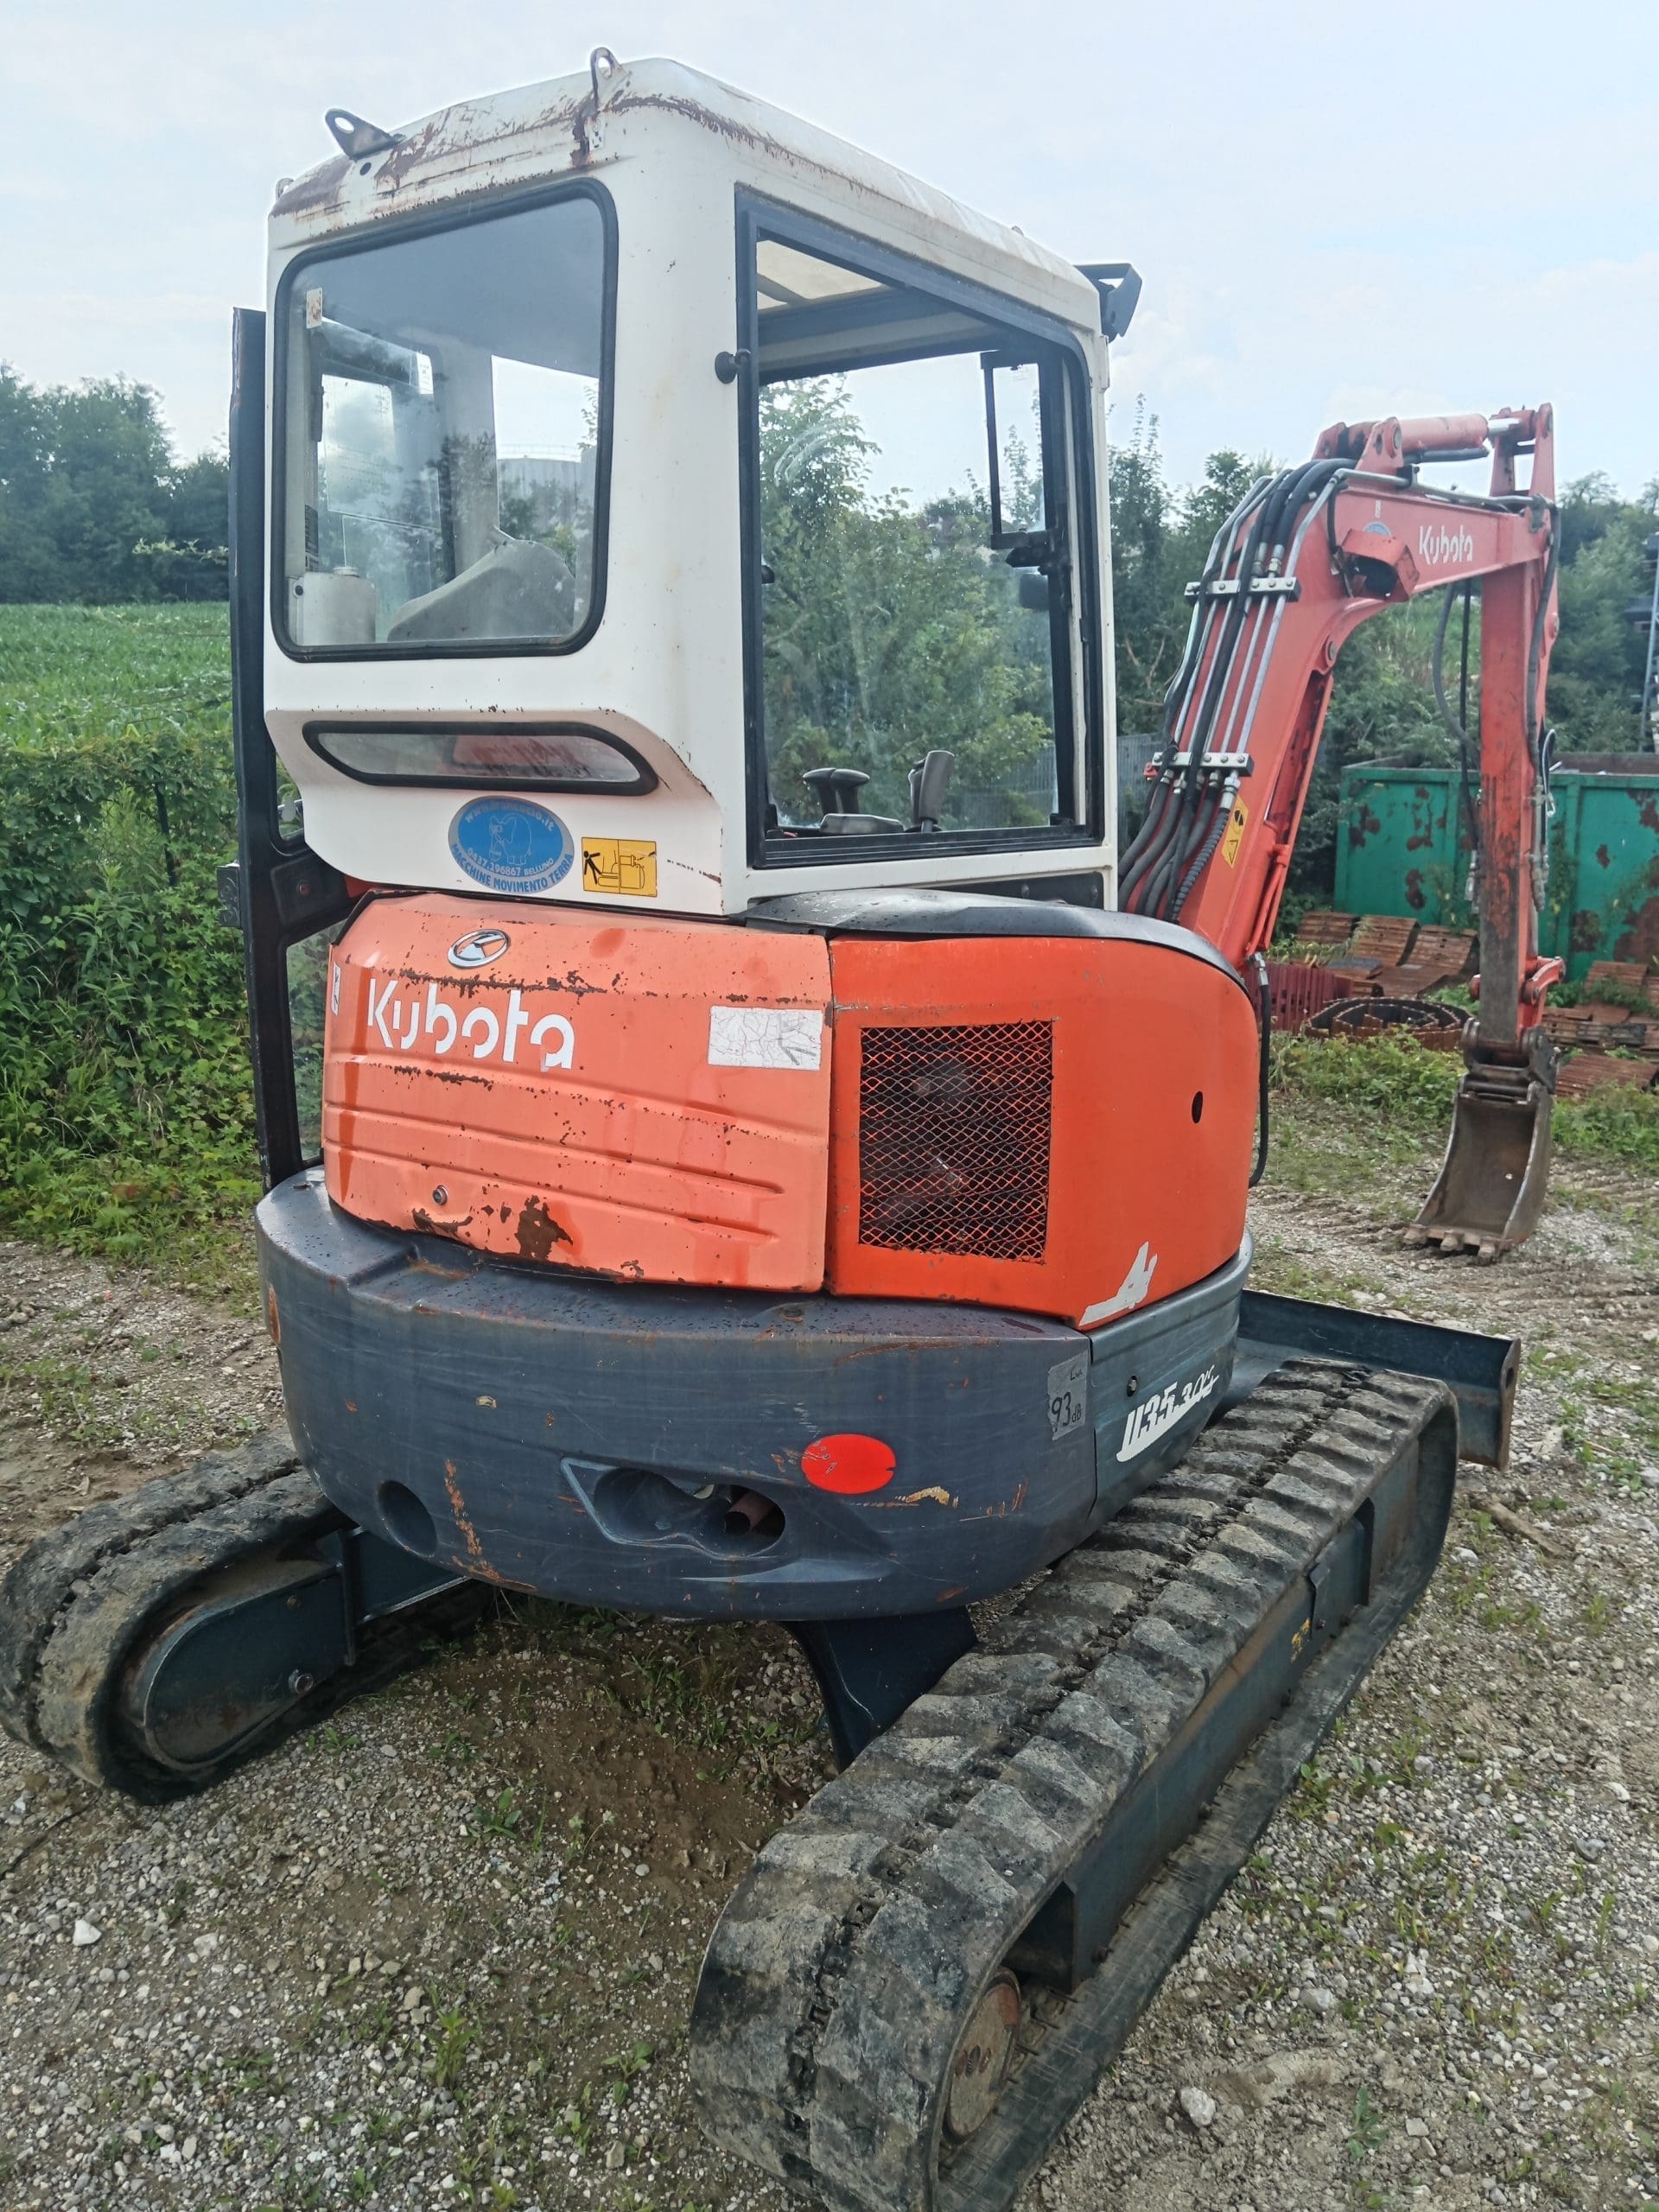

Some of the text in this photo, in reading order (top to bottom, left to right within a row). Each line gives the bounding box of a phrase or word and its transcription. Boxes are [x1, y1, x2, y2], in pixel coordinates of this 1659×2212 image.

[1419, 524, 1473, 565] Kubota
[451, 843, 574, 893] MACCHINE MOVIMENTO TERRA
[524, 858, 554, 876] BELLUNO
[367, 977, 575, 1071] Kubota
[1051, 1391, 1082, 1433] 93 dB
